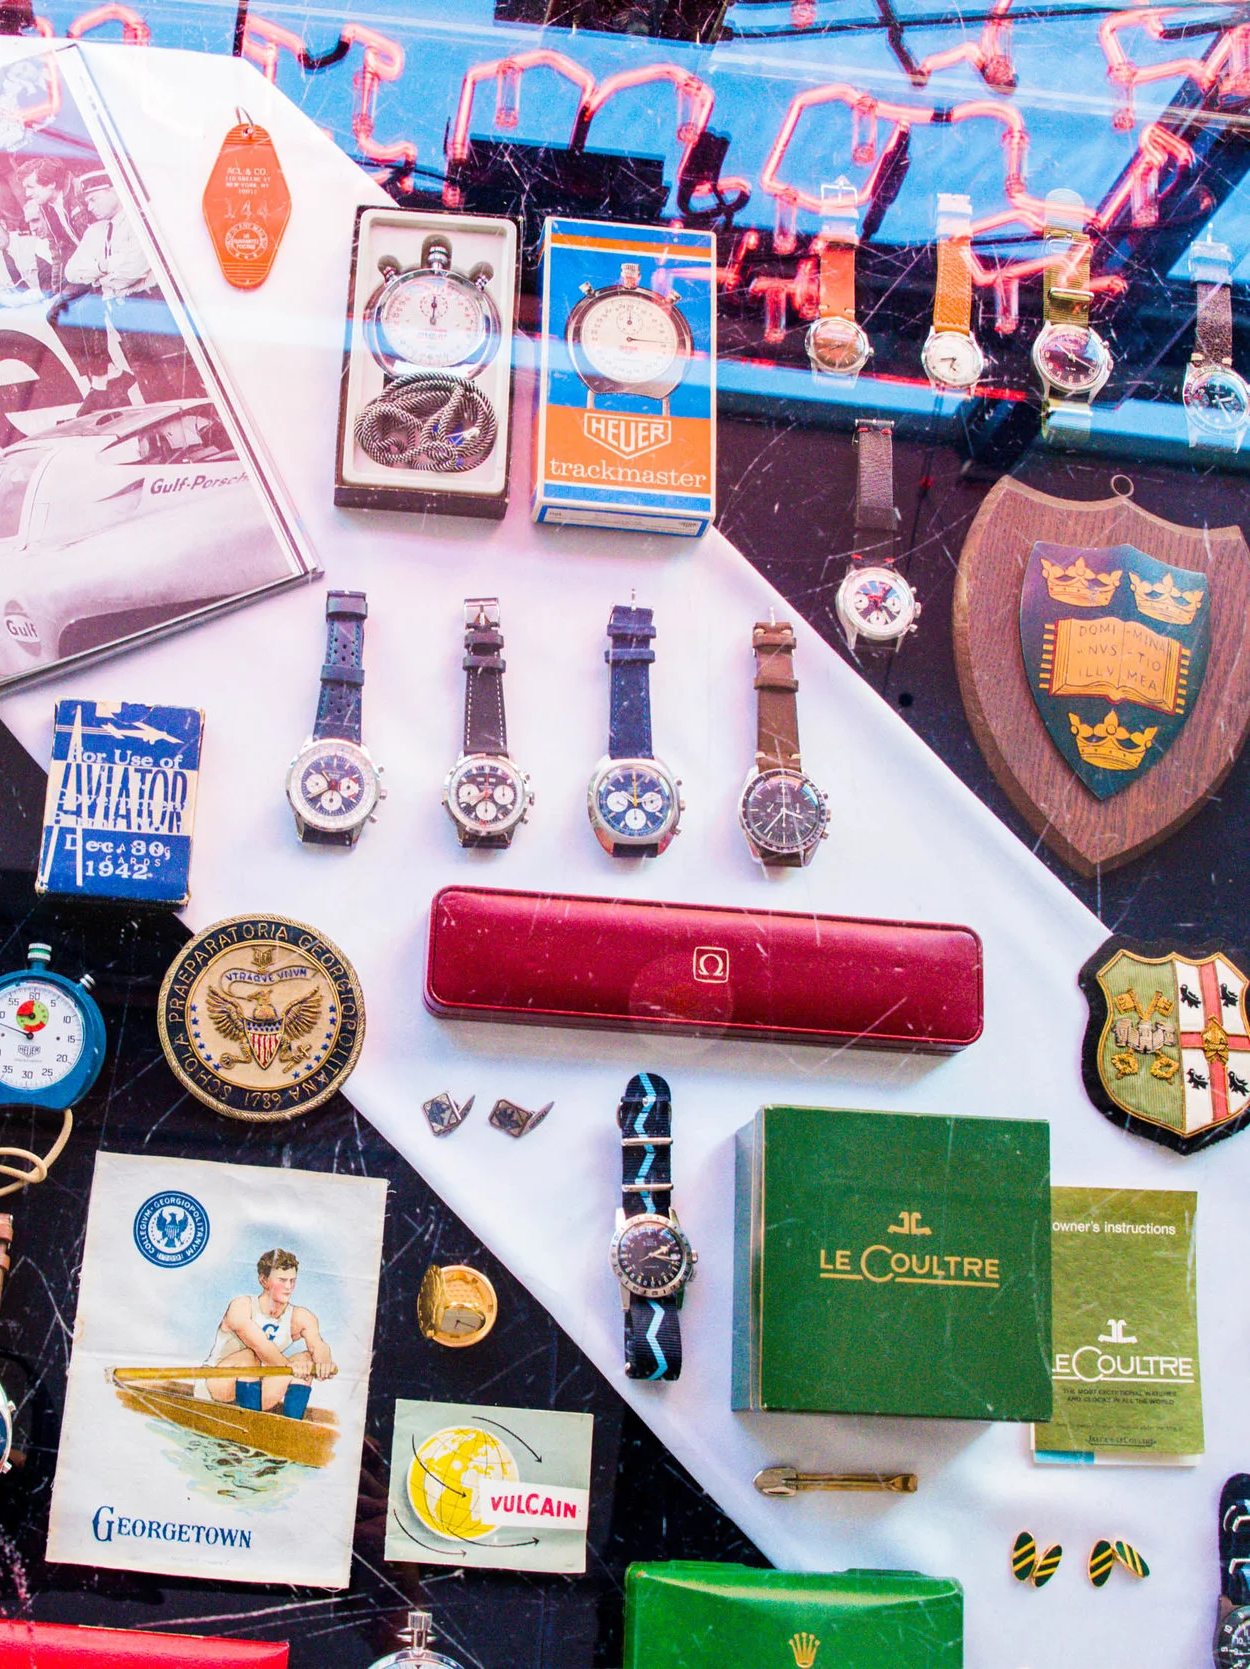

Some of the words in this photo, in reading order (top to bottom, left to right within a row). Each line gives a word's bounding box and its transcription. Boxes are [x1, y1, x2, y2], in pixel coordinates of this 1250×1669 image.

[590, 417, 666, 452] HEUER
[549, 457, 706, 488] trackmaster
[5, 619, 38, 638] Gulf
[1079, 624, 1115, 636] DOMI
[1079, 666, 1114, 677] ILLV
[1127, 670, 1157, 691] MEA
[114, 749, 153, 766] Use
[160, 754, 182, 769] of
[169, 922, 288, 1022] PRAEPARATORIA
[8, 998, 19, 1006] 55
[29, 992, 40, 1000] 60
[68, 1035, 75, 1043] 15
[18, 1046, 41, 1057] HEUER
[2, 1066, 13, 1074] 35
[22, 1071, 33, 1079] 30
[42, 1068, 53, 1076] 25
[173, 1033, 232, 1100] SCHOLA
[244, 1092, 282, 1110] 1789
[1053, 1221, 1100, 1232] owner's
[1104, 1222, 1176, 1235] instructions
[820, 1249, 851, 1272] LE
[861, 1244, 1000, 1284] COULTRE
[1072, 1346, 1194, 1382] COULTRE
[490, 1491, 577, 1519] VULCAIN
[91, 1505, 252, 1548] GEORGETOWN
